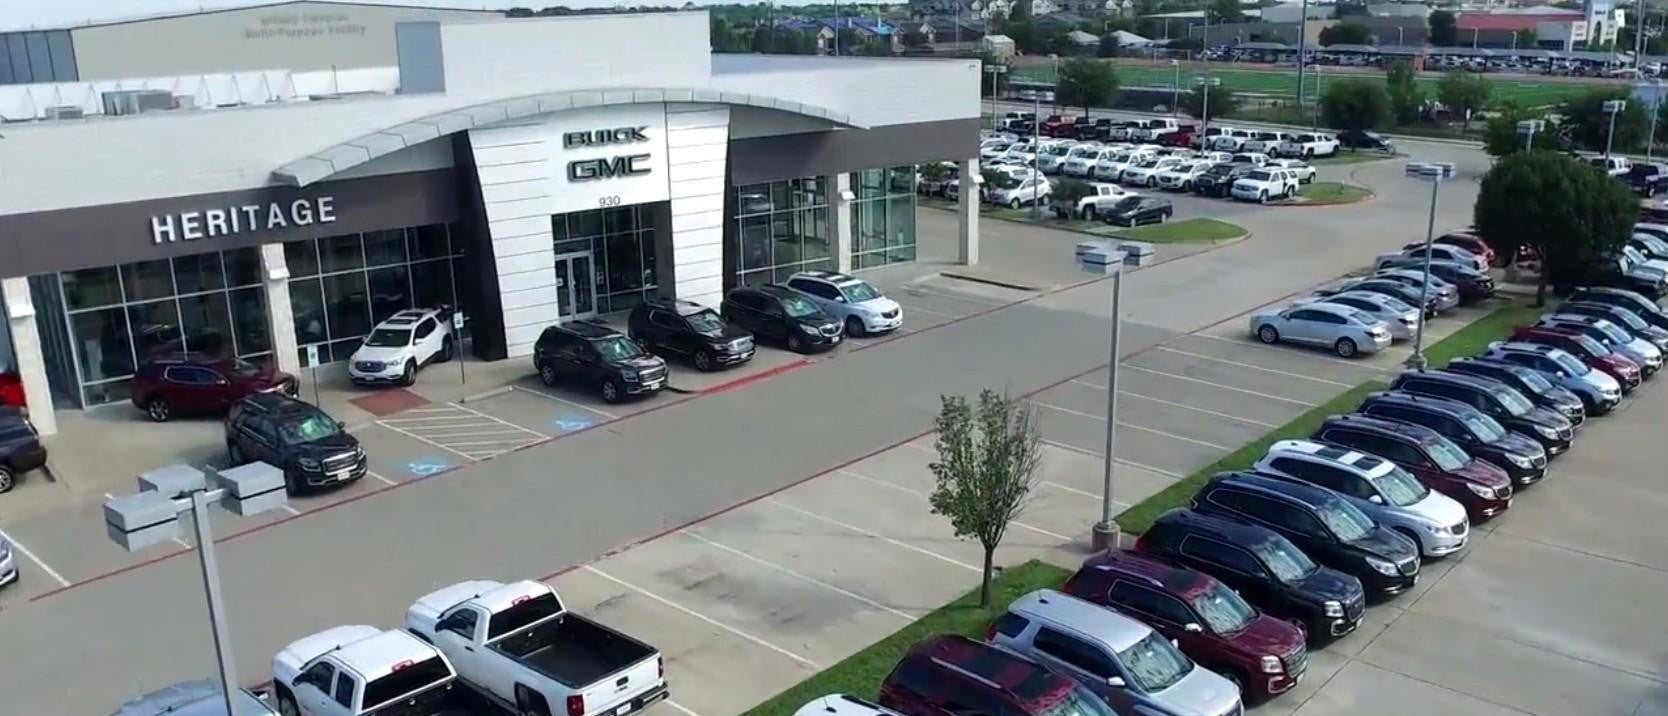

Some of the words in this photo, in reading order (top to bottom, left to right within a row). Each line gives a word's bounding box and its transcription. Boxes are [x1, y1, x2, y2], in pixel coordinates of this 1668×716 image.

[562, 125, 650, 149] BUICK
[566, 153, 651, 182] GMC
[599, 195, 621, 207] 930
[151, 196, 337, 244] HERITAGE
